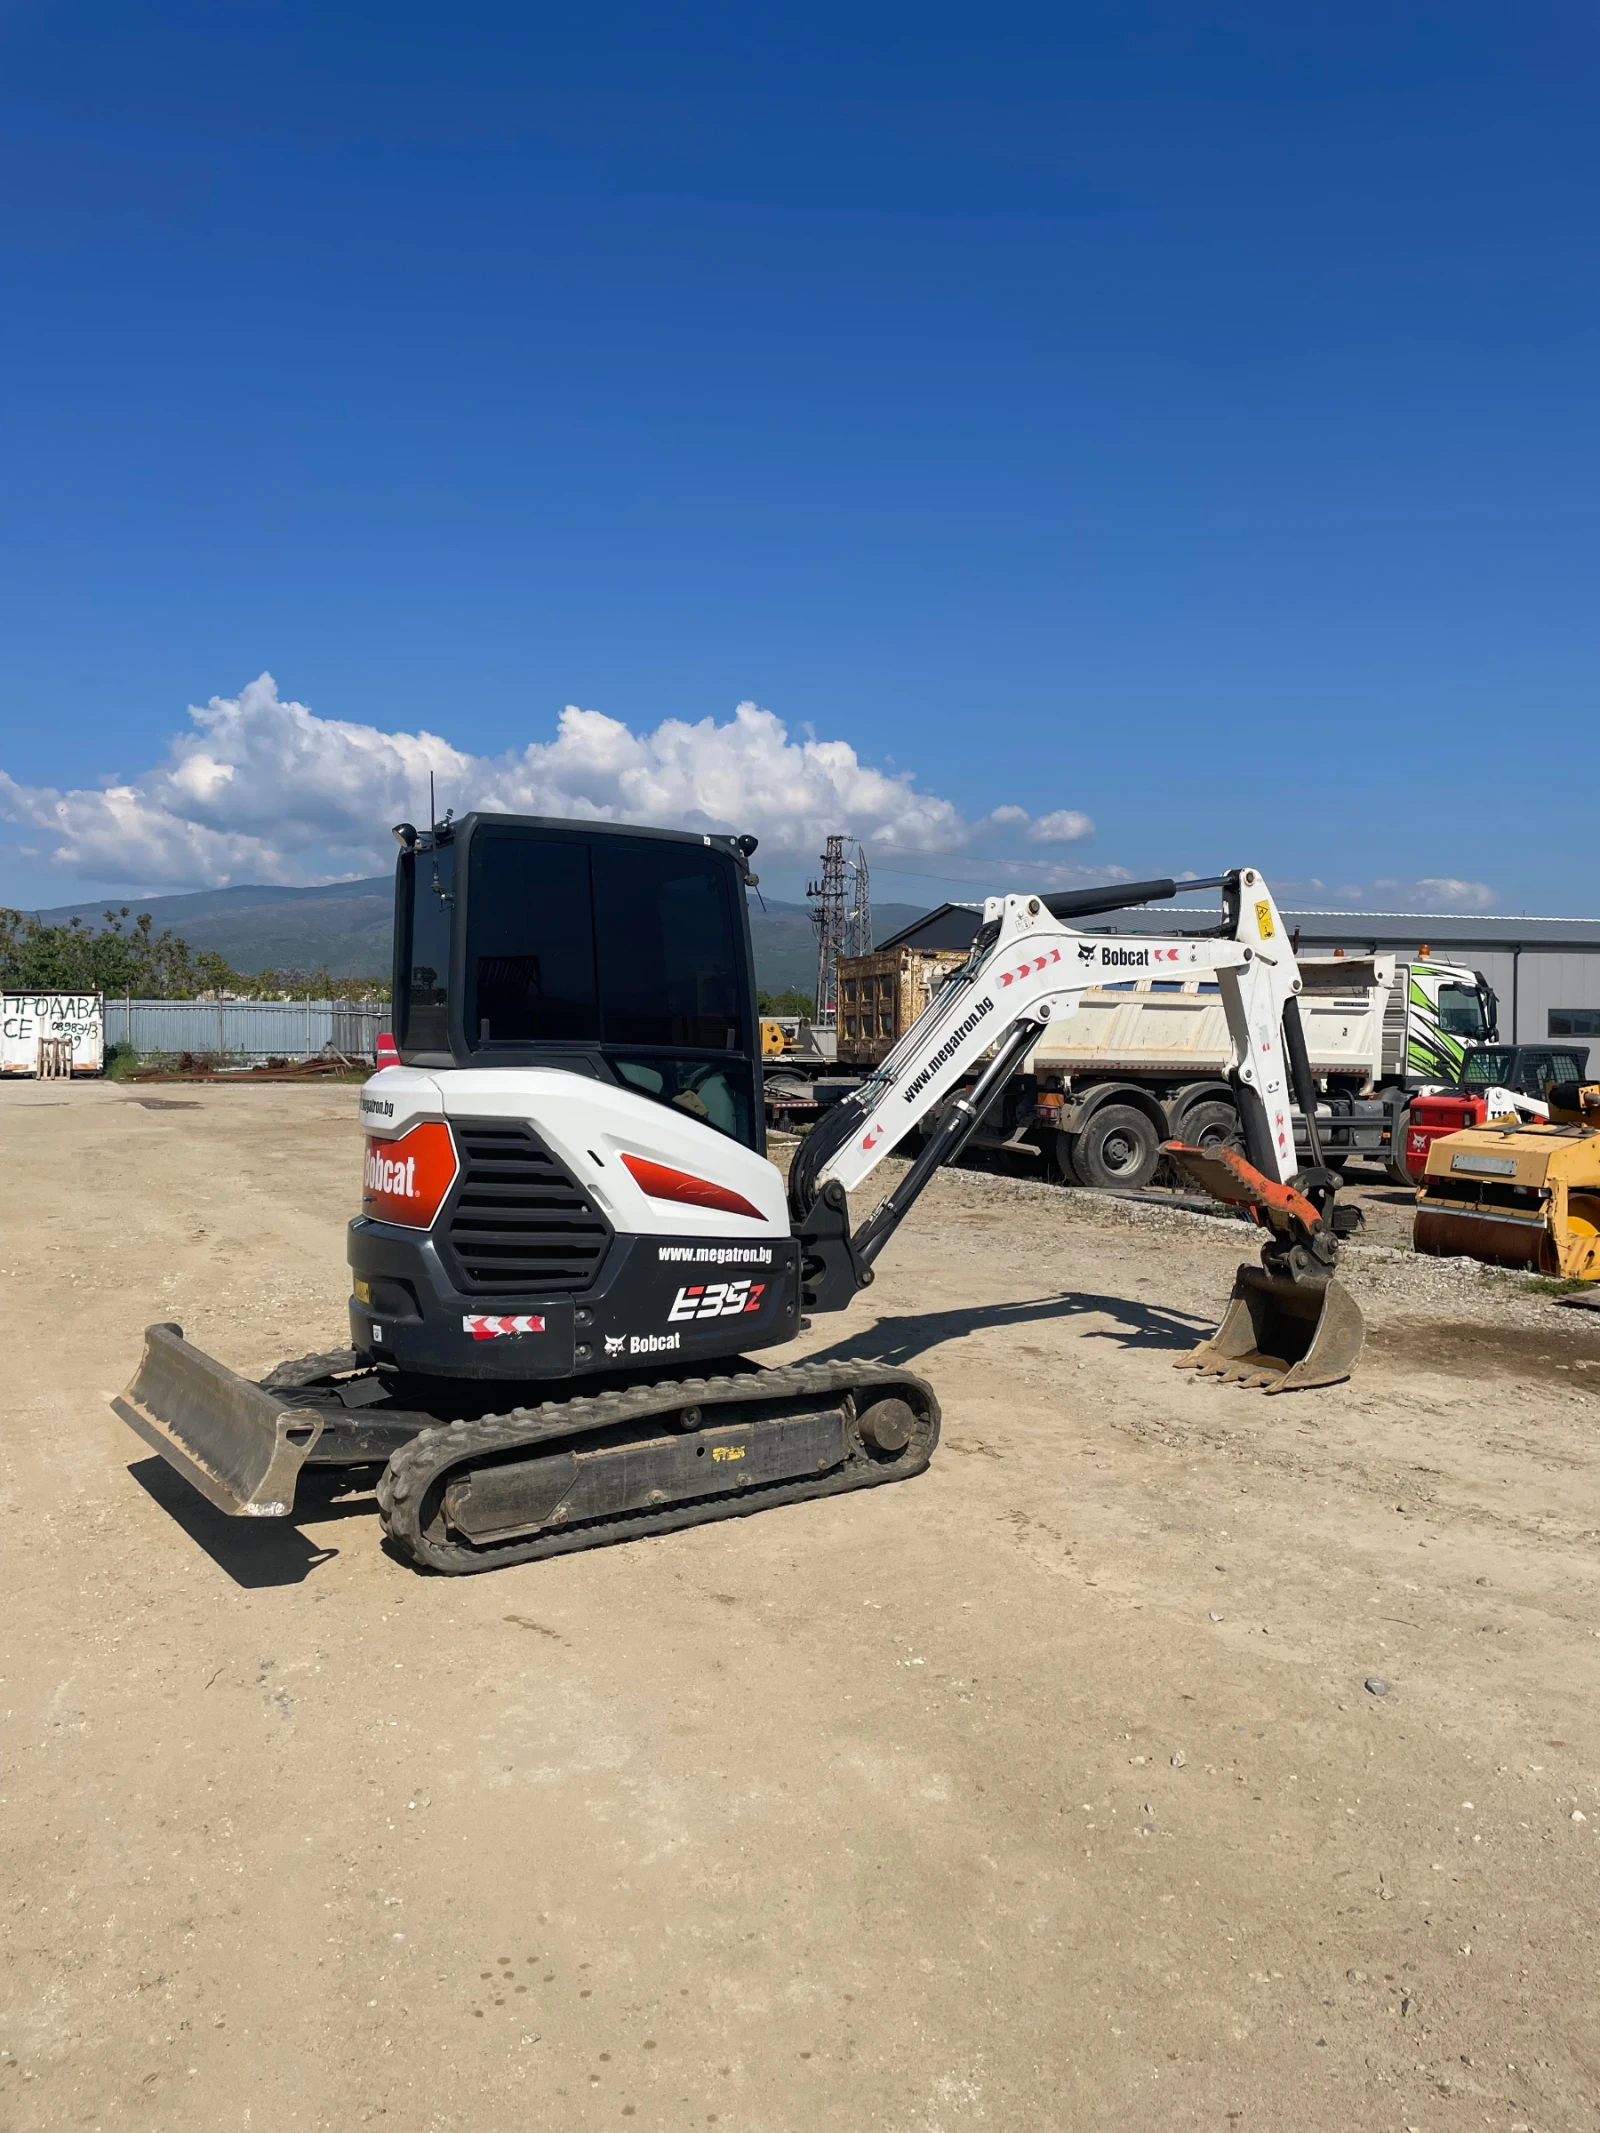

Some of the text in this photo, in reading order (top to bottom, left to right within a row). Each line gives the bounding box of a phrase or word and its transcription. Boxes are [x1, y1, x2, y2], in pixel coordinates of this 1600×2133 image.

[1101, 947, 1149, 966] Bobcat
[3, 997, 103, 1020] ПРОДАВА
[4, 1018, 32, 1040] СЕ
[902, 996, 995, 1104] www.megatron.bg
[364, 1149, 415, 1198] Bobcat
[658, 1247, 772, 1264] www.megatron.bg
[630, 1332, 680, 1354] Bobcat
